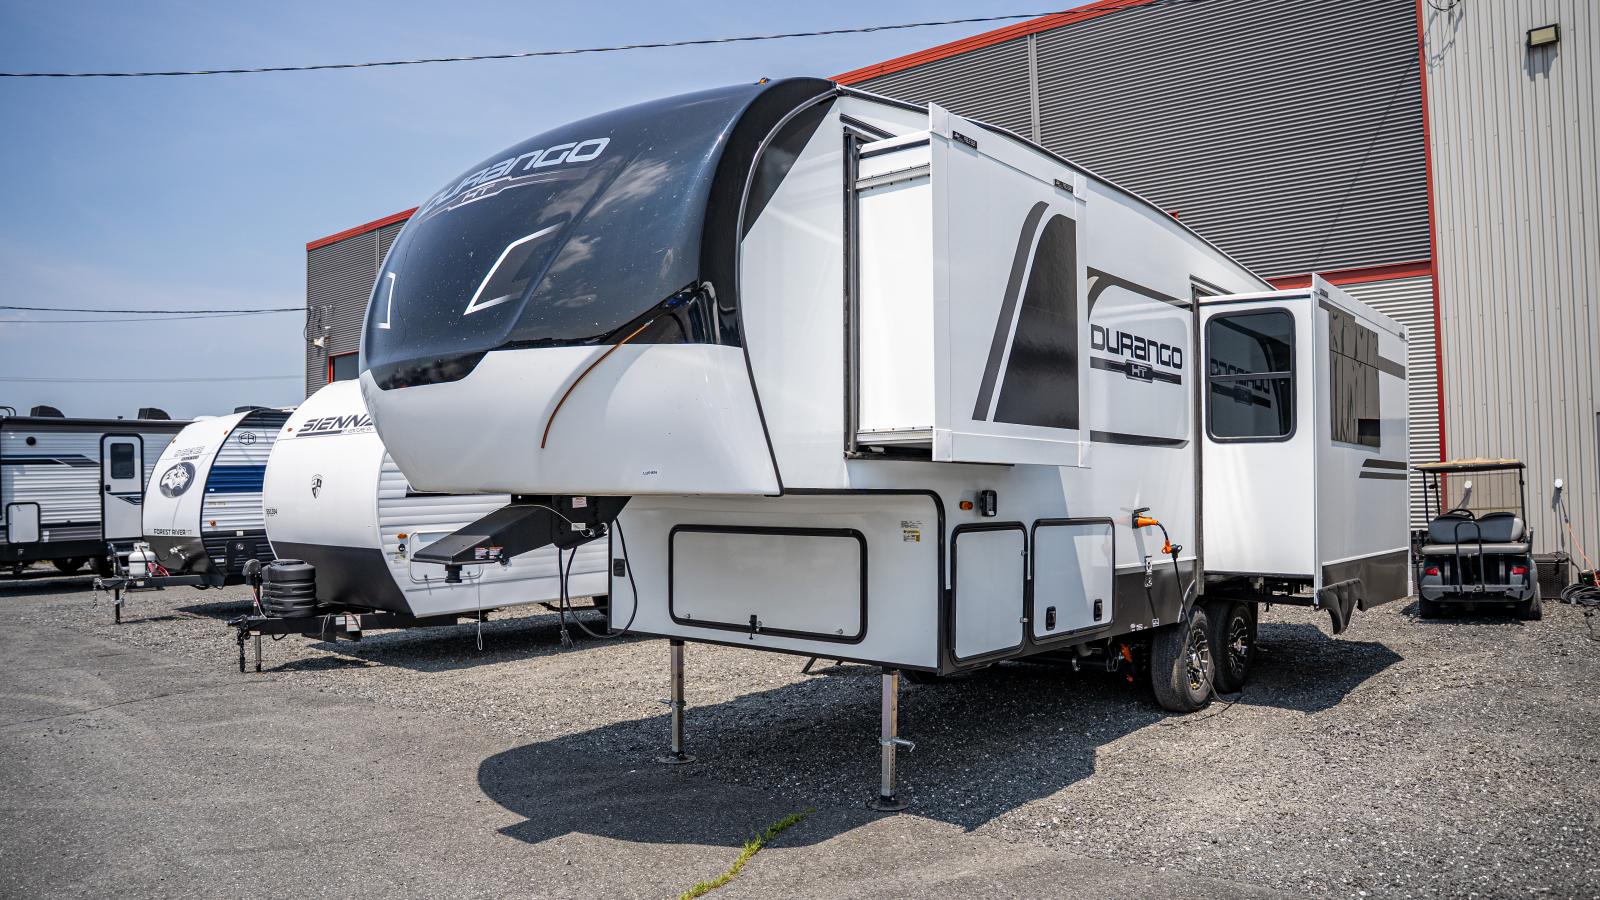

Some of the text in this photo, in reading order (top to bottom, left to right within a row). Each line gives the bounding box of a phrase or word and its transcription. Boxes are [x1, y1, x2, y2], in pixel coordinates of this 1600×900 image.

[461, 183, 496, 203] HT
[1131, 364, 1148, 378] HT
[153, 528, 171, 536] FOREST
